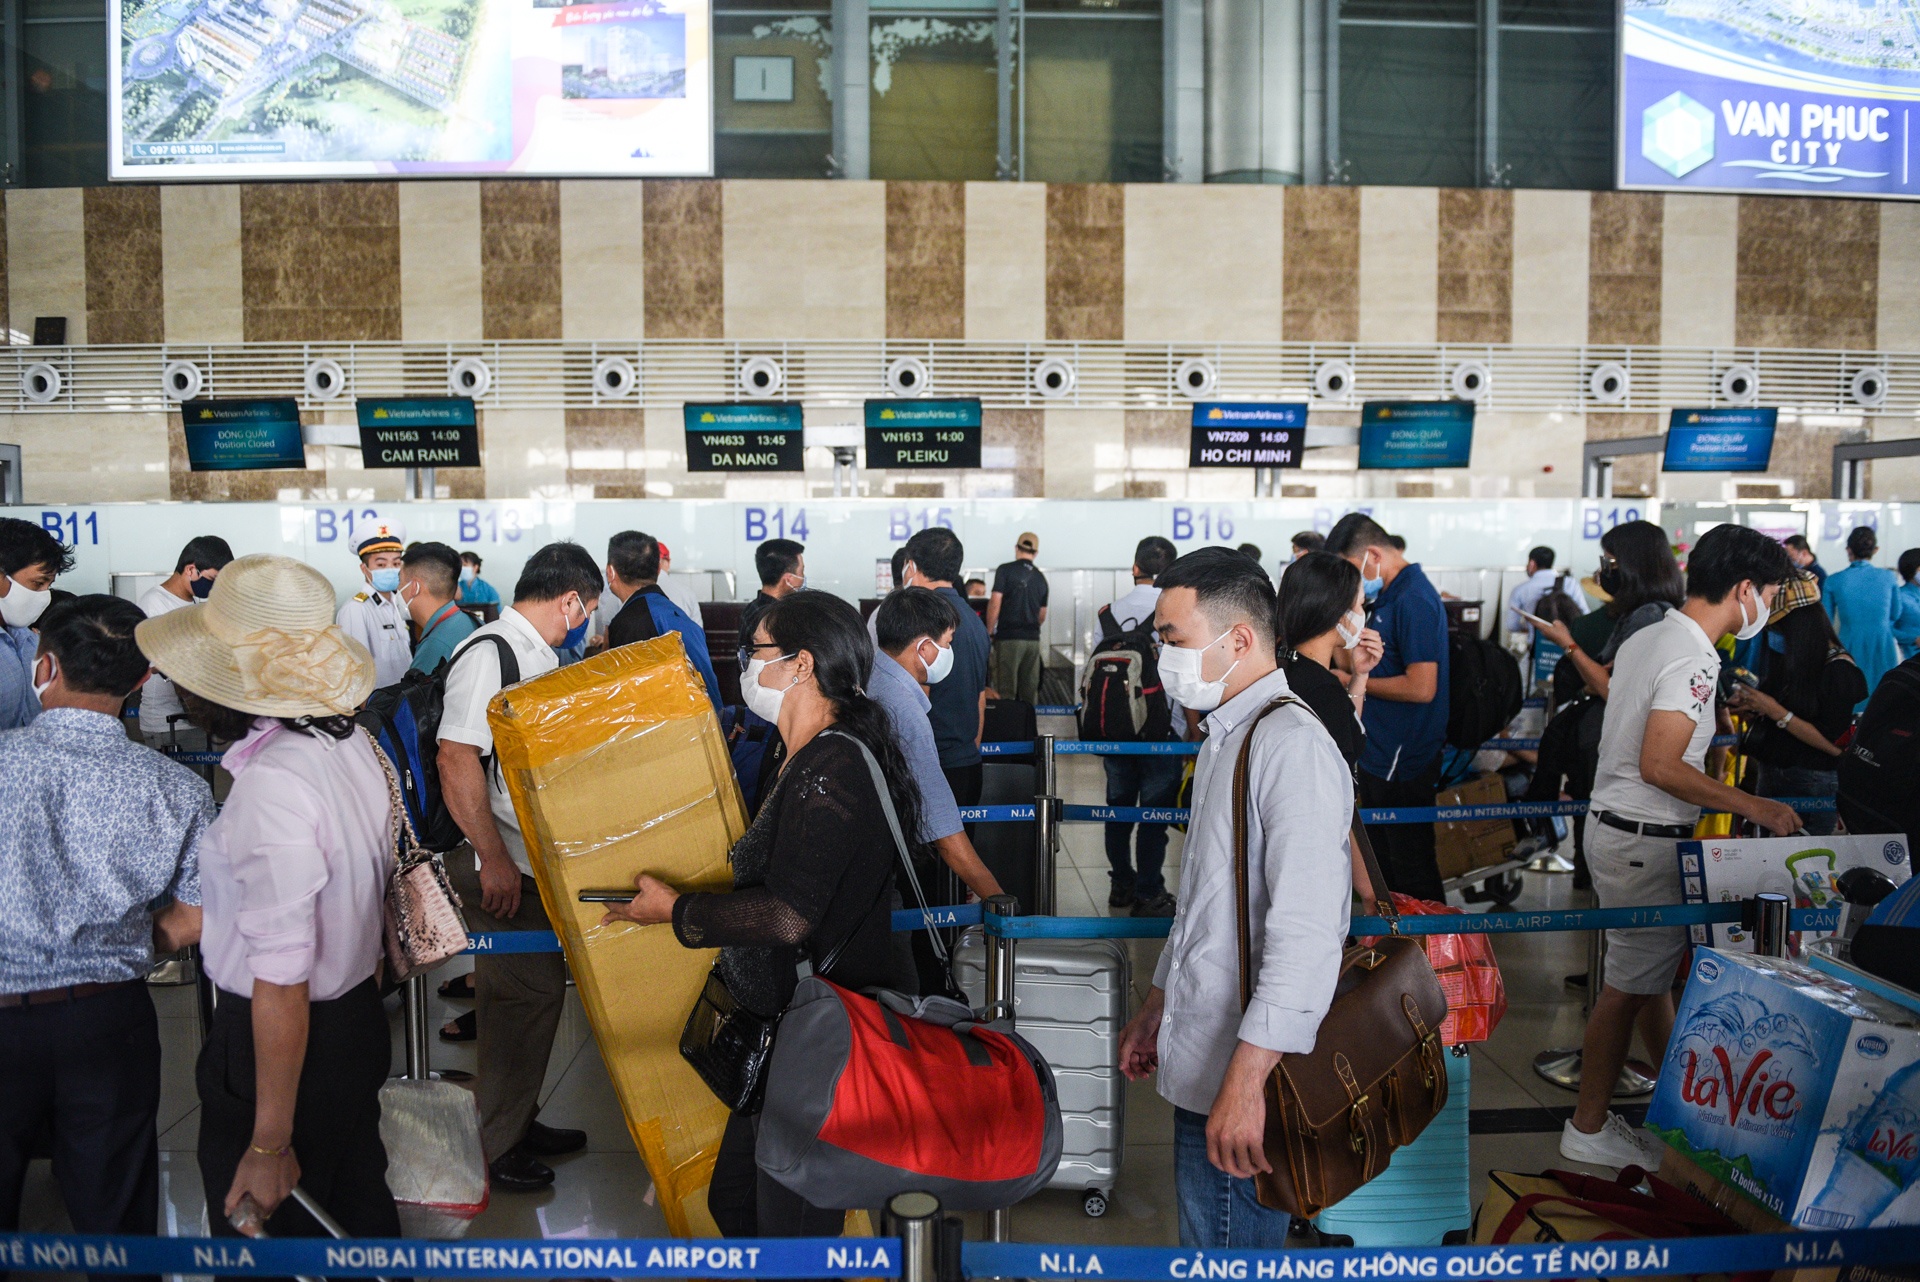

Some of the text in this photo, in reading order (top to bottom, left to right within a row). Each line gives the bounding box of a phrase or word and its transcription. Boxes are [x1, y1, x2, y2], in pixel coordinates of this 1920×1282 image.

[1721, 99, 1889, 142] VAN PHUC
[1771, 140, 1841, 165] CITY
[214, 439, 275, 449] Position Closed
[376, 430, 460, 442] VN1563 14:00
[702, 435, 786, 446] VN4633 13:45
[881, 431, 965, 442] VN1613 14:00
[1207, 431, 1289, 443] VN7209 14:00
[381, 448, 459, 462] CAM RANH
[711, 453, 778, 466] DA NANG
[897, 450, 949, 463] PLEIKU
[1201, 449, 1291, 463] HO CHI MINH
[41, 511, 98, 545] B11
[459, 509, 523, 542] B13
[745, 508, 809, 541] B14
[1173, 507, 1235, 541] B16
[1011, 809, 1035, 818] N.I.A
[1091, 809, 1116, 819] N.I.A
[1372, 812, 1396, 822] N.I.A
[1437, 809, 1472, 819] NOIBAI
[1474, 802, 1554, 816] INTERNATIONAL
[923, 911, 956, 925] N.I.A
[1697, 1109, 1796, 1140] Natural Mineral Water
[1730, 1167, 1741, 1182] 12
[1739, 1171, 1764, 1200] bottles
[33, 1243, 77, 1270] NỘI
[194, 1247, 256, 1268] N.I.A
[326, 1247, 760, 1269] NOIBAI INTERNATIONAL AIRPORT
[826, 1247, 890, 1269] N.I.A
[1784, 1240, 1845, 1263] N.I.A
[1040, 1254, 1103, 1275] N.I.A
[1170, 1251, 1247, 1280] CẢNG
[1342, 1252, 1437, 1279] KHÔNG
[1446, 1248, 1523, 1277] QUỐC
[1532, 1245, 1564, 1273] TẾ
[1570, 1247, 1617, 1274] NỘI
